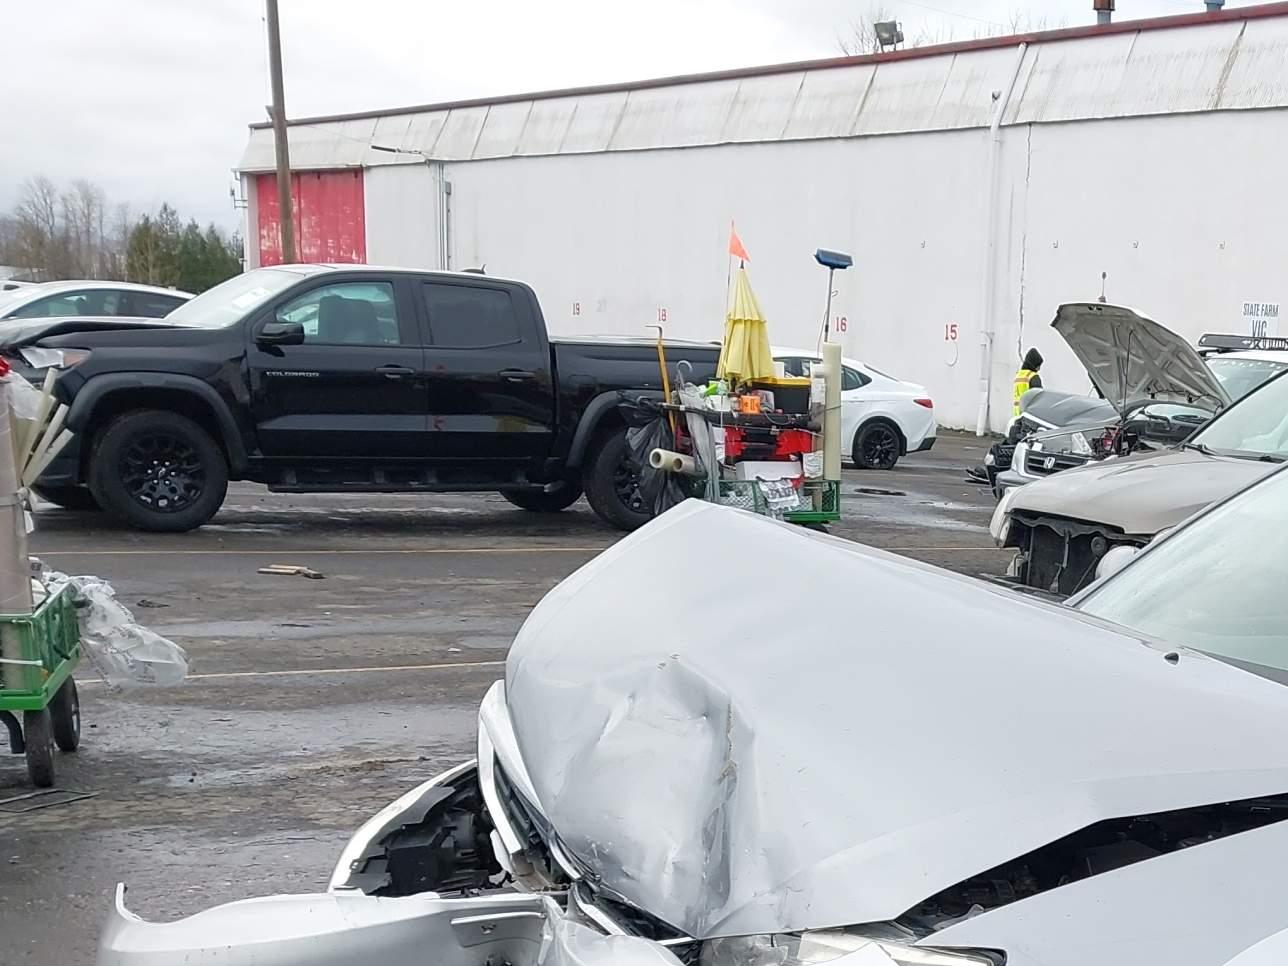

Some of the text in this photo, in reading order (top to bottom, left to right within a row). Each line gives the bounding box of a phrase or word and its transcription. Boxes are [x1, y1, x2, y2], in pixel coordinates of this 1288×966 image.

[572, 302, 581, 316] 19
[657, 308, 667, 322] 18
[1243, 303, 1280, 318] STATE FARM
[835, 316, 848, 332] 16
[1252, 319, 1267, 338] VIC
[944, 323, 958, 341] 15
